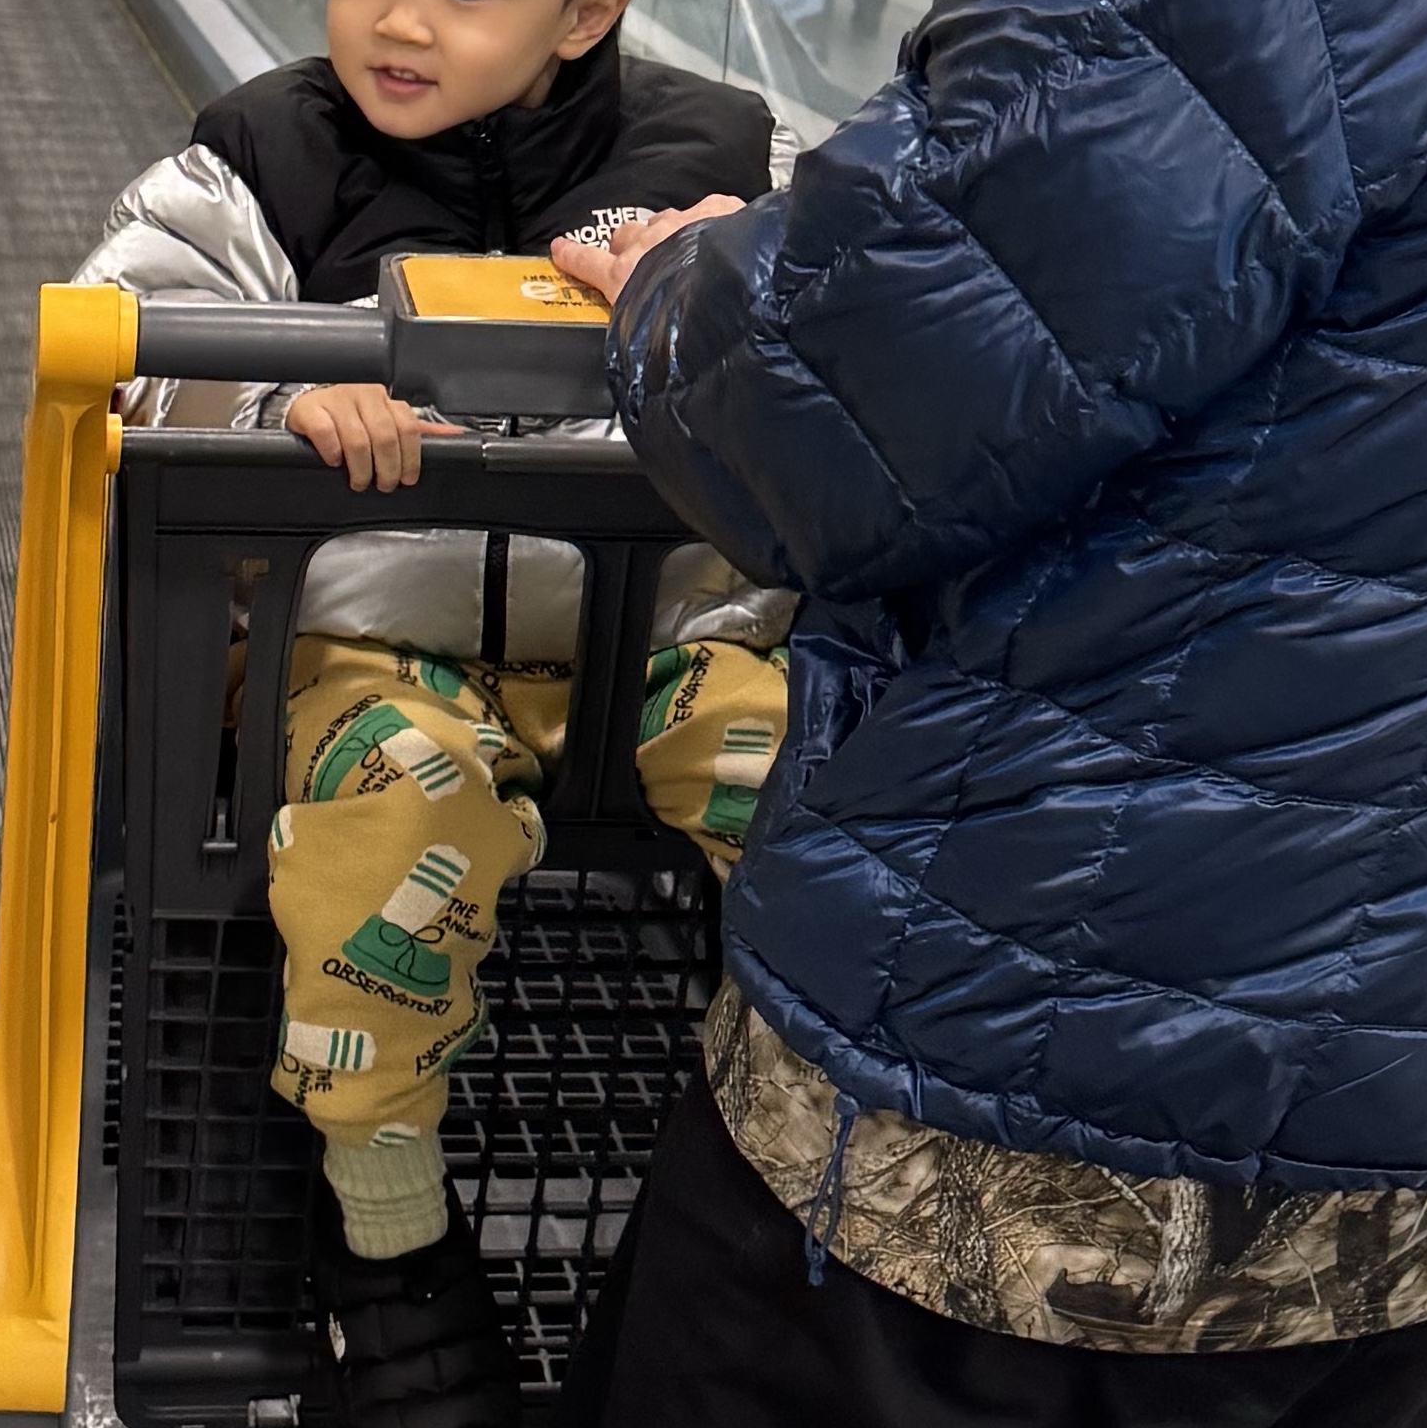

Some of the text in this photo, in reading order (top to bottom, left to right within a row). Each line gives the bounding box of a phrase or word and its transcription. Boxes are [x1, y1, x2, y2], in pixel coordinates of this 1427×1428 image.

[565, 223, 612, 244] NOR
[446, 896, 480, 920] THE
[322, 957, 454, 1017] OBSERVATORY
